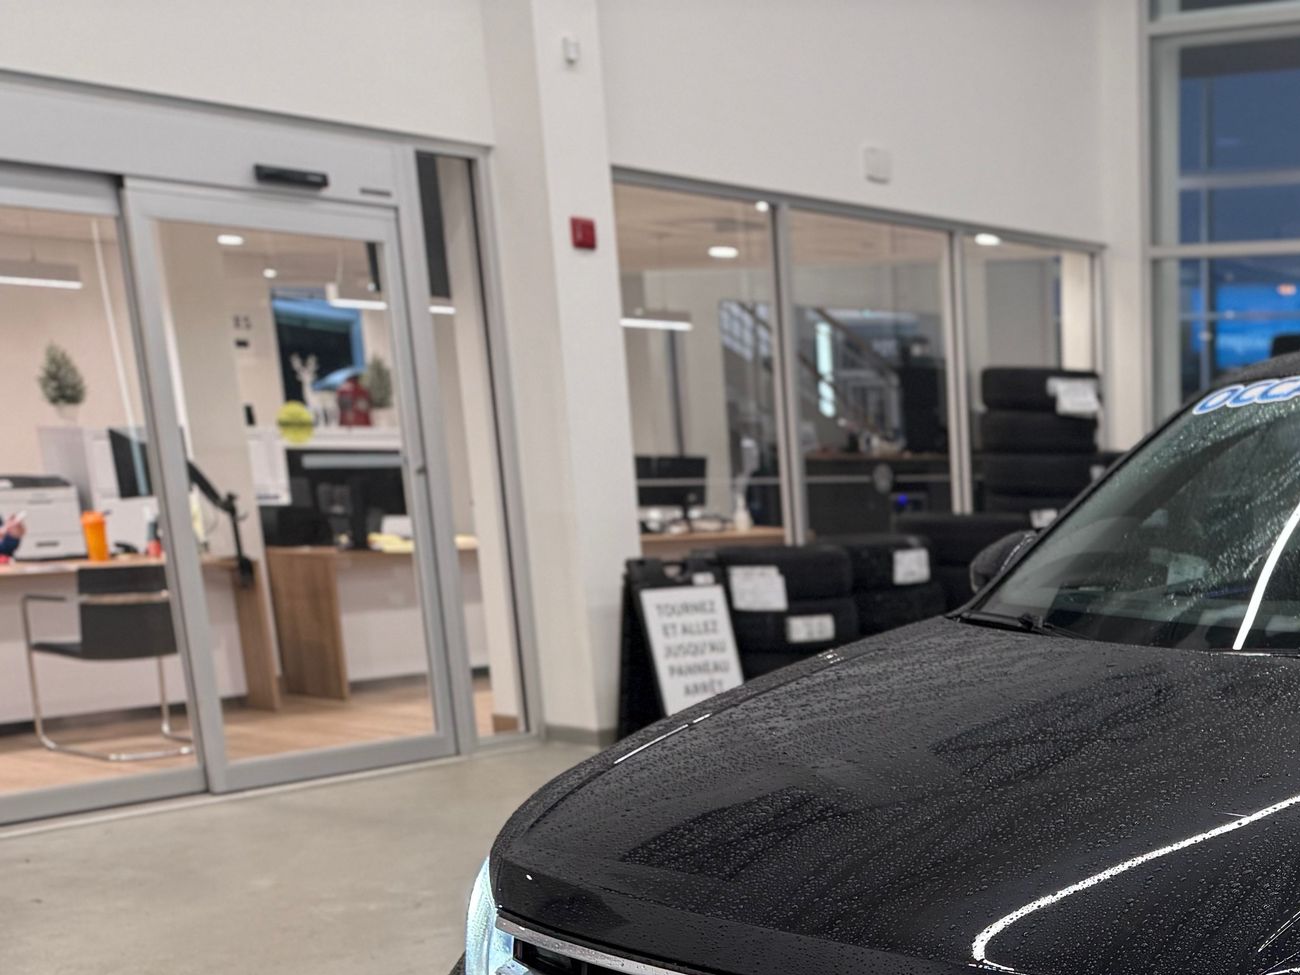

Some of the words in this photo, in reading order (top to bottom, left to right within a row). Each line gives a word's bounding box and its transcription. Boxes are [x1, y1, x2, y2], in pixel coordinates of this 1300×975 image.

[655, 600, 716, 617] TOURNEZ
[662, 623, 678, 638] ET
[681, 620, 719, 636] ALLEZ
[668, 661, 730, 678] PANNEAU
